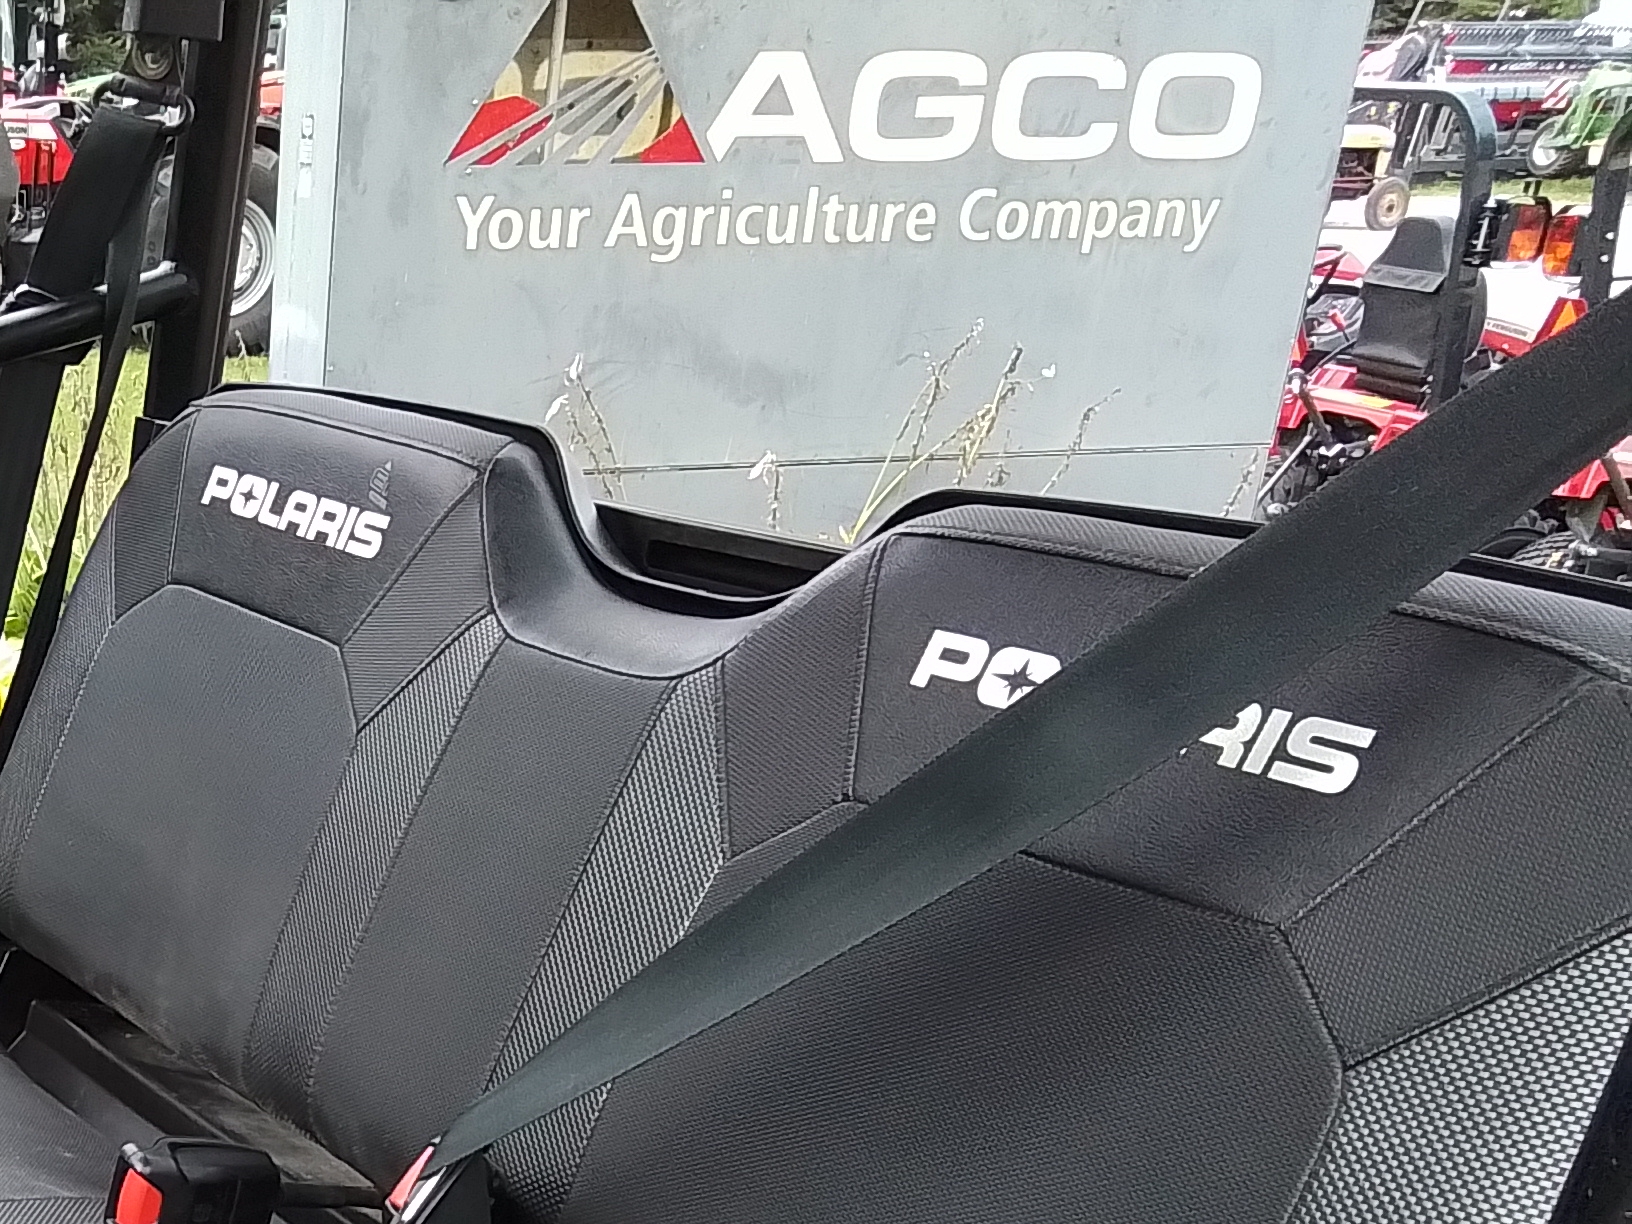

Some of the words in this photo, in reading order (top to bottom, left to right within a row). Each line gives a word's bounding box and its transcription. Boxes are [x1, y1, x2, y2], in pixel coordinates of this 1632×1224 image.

[706, 49, 1262, 163] AGCO
[455, 193, 590, 252] Your
[605, 187, 937, 264] Agriculture
[959, 188, 1222, 254] Company
[200, 464, 392, 559] POLARIS
